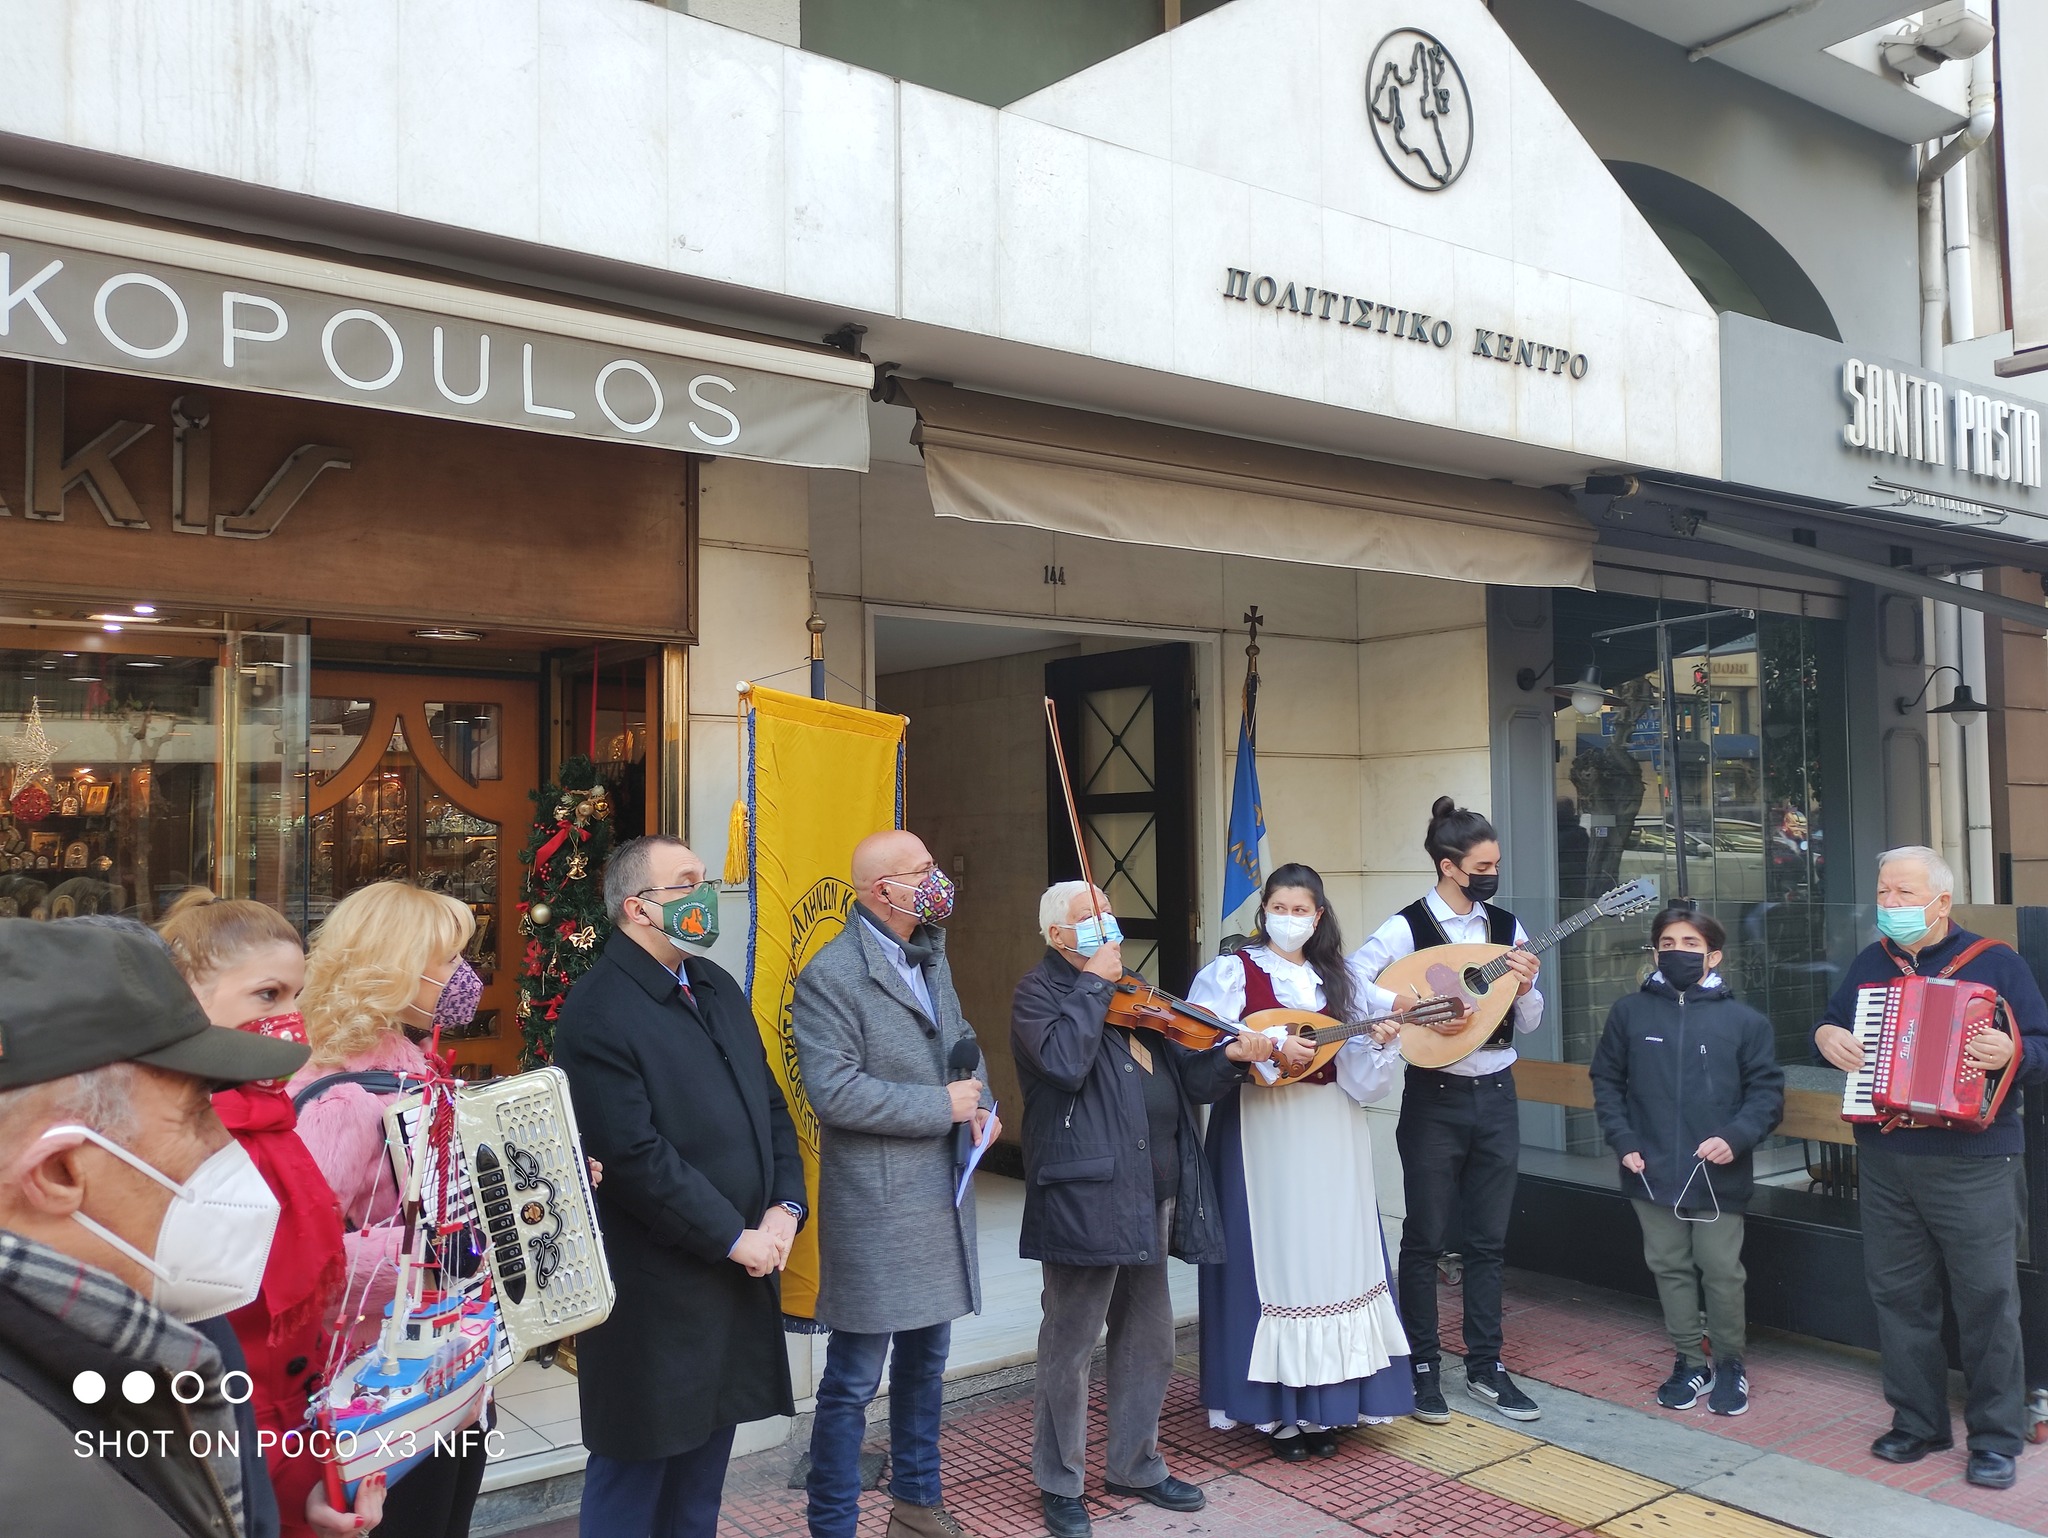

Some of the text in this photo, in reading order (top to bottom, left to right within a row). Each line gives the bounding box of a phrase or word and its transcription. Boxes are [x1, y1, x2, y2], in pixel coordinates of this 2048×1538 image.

[1223, 267, 1589, 380] ΠΟΛΙΤΙΣΤΙΚΟ ΚΕΝΤΡΟ
[1843, 358, 2042, 488] SANTA PASTA
[1043, 565, 1067, 586] 144
